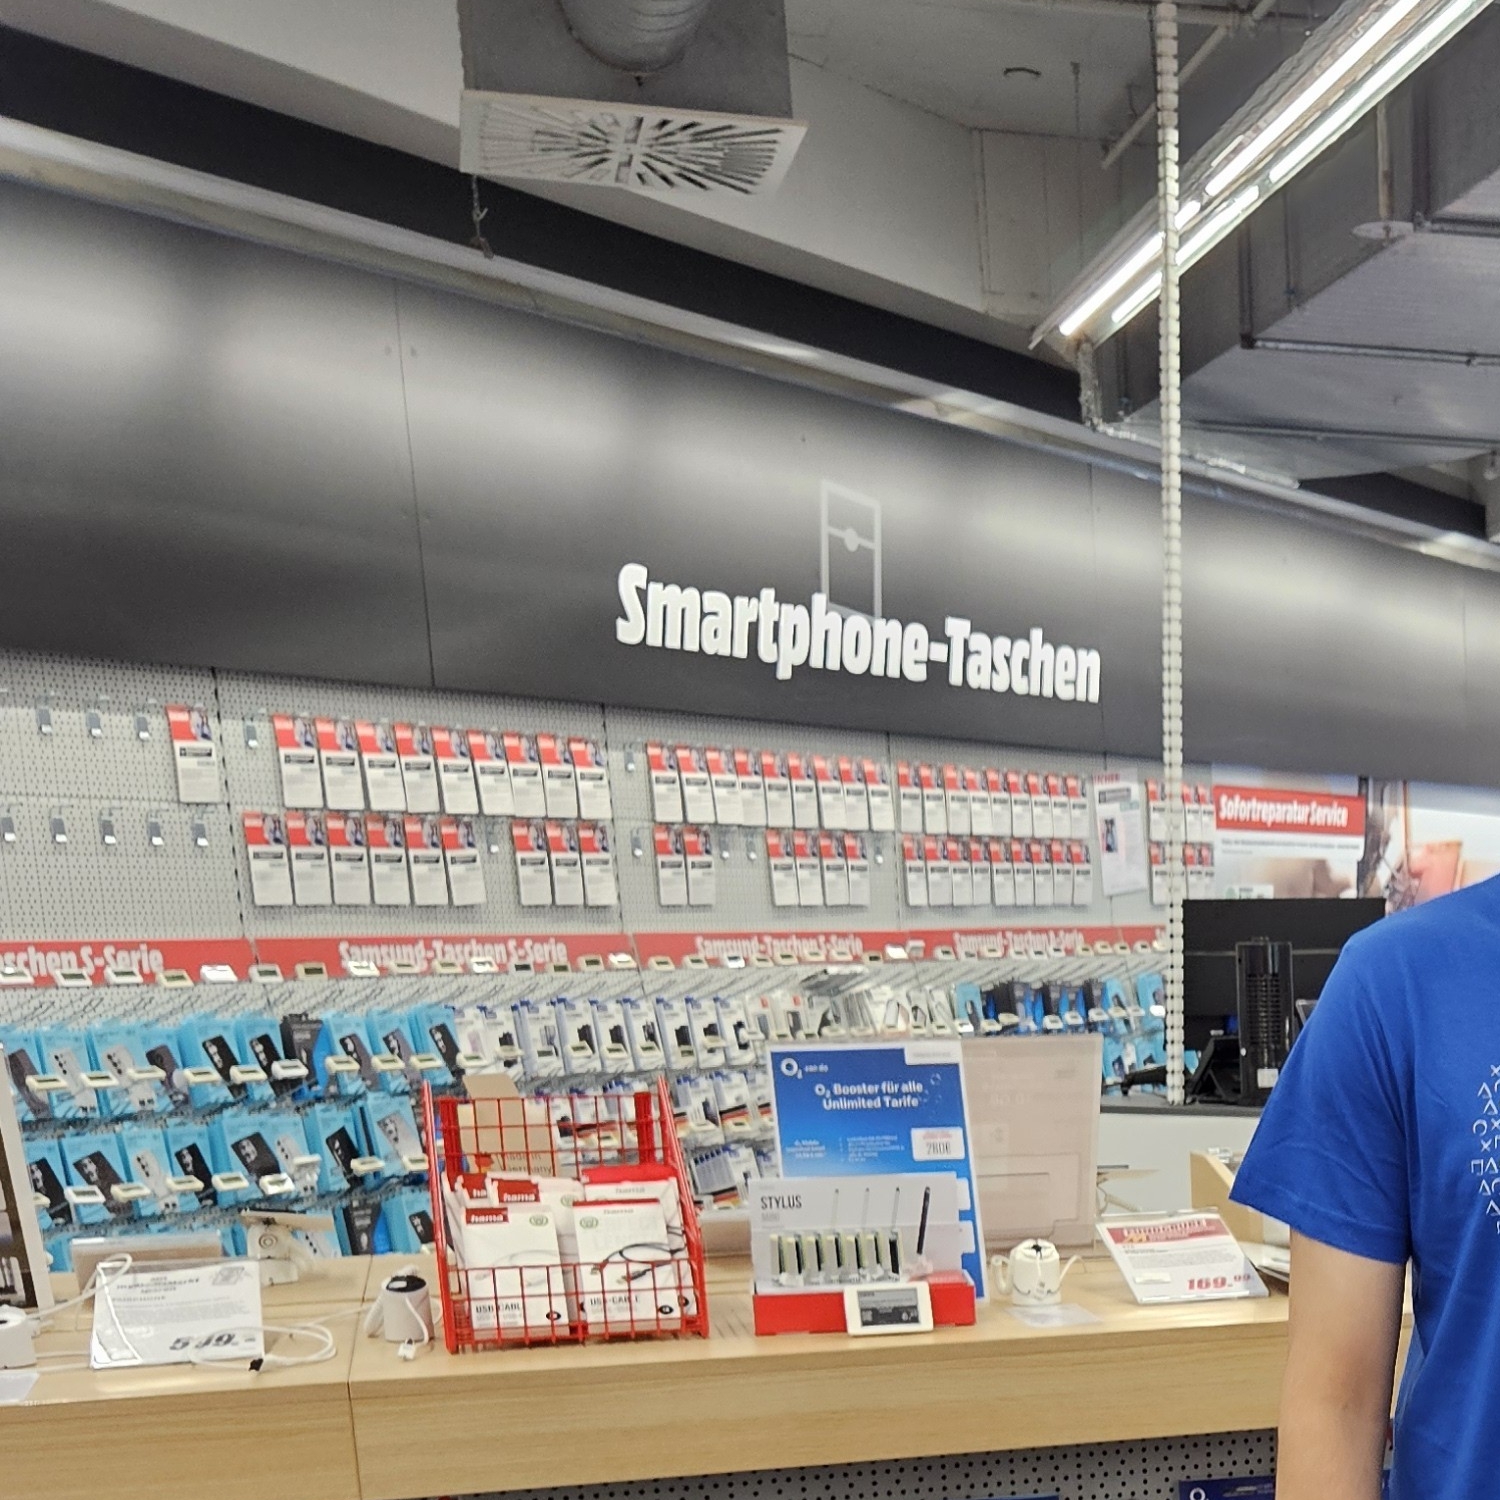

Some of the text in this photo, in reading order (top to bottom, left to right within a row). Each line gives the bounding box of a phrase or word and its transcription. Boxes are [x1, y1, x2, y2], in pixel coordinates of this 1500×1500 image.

[615, 563, 1100, 703] Smartphone-Taschen
[0, 945, 78, 977] schen
[833, 1082, 879, 1096] Booster
[881, 1079, 899, 1094] für
[902, 1080, 923, 1093] alle
[822, 1094, 919, 1111] Unlimited Tarife
[503, 1191, 536, 1202] hama
[760, 1195, 802, 1209] STYLUS
[470, 1213, 503, 1223] hama
